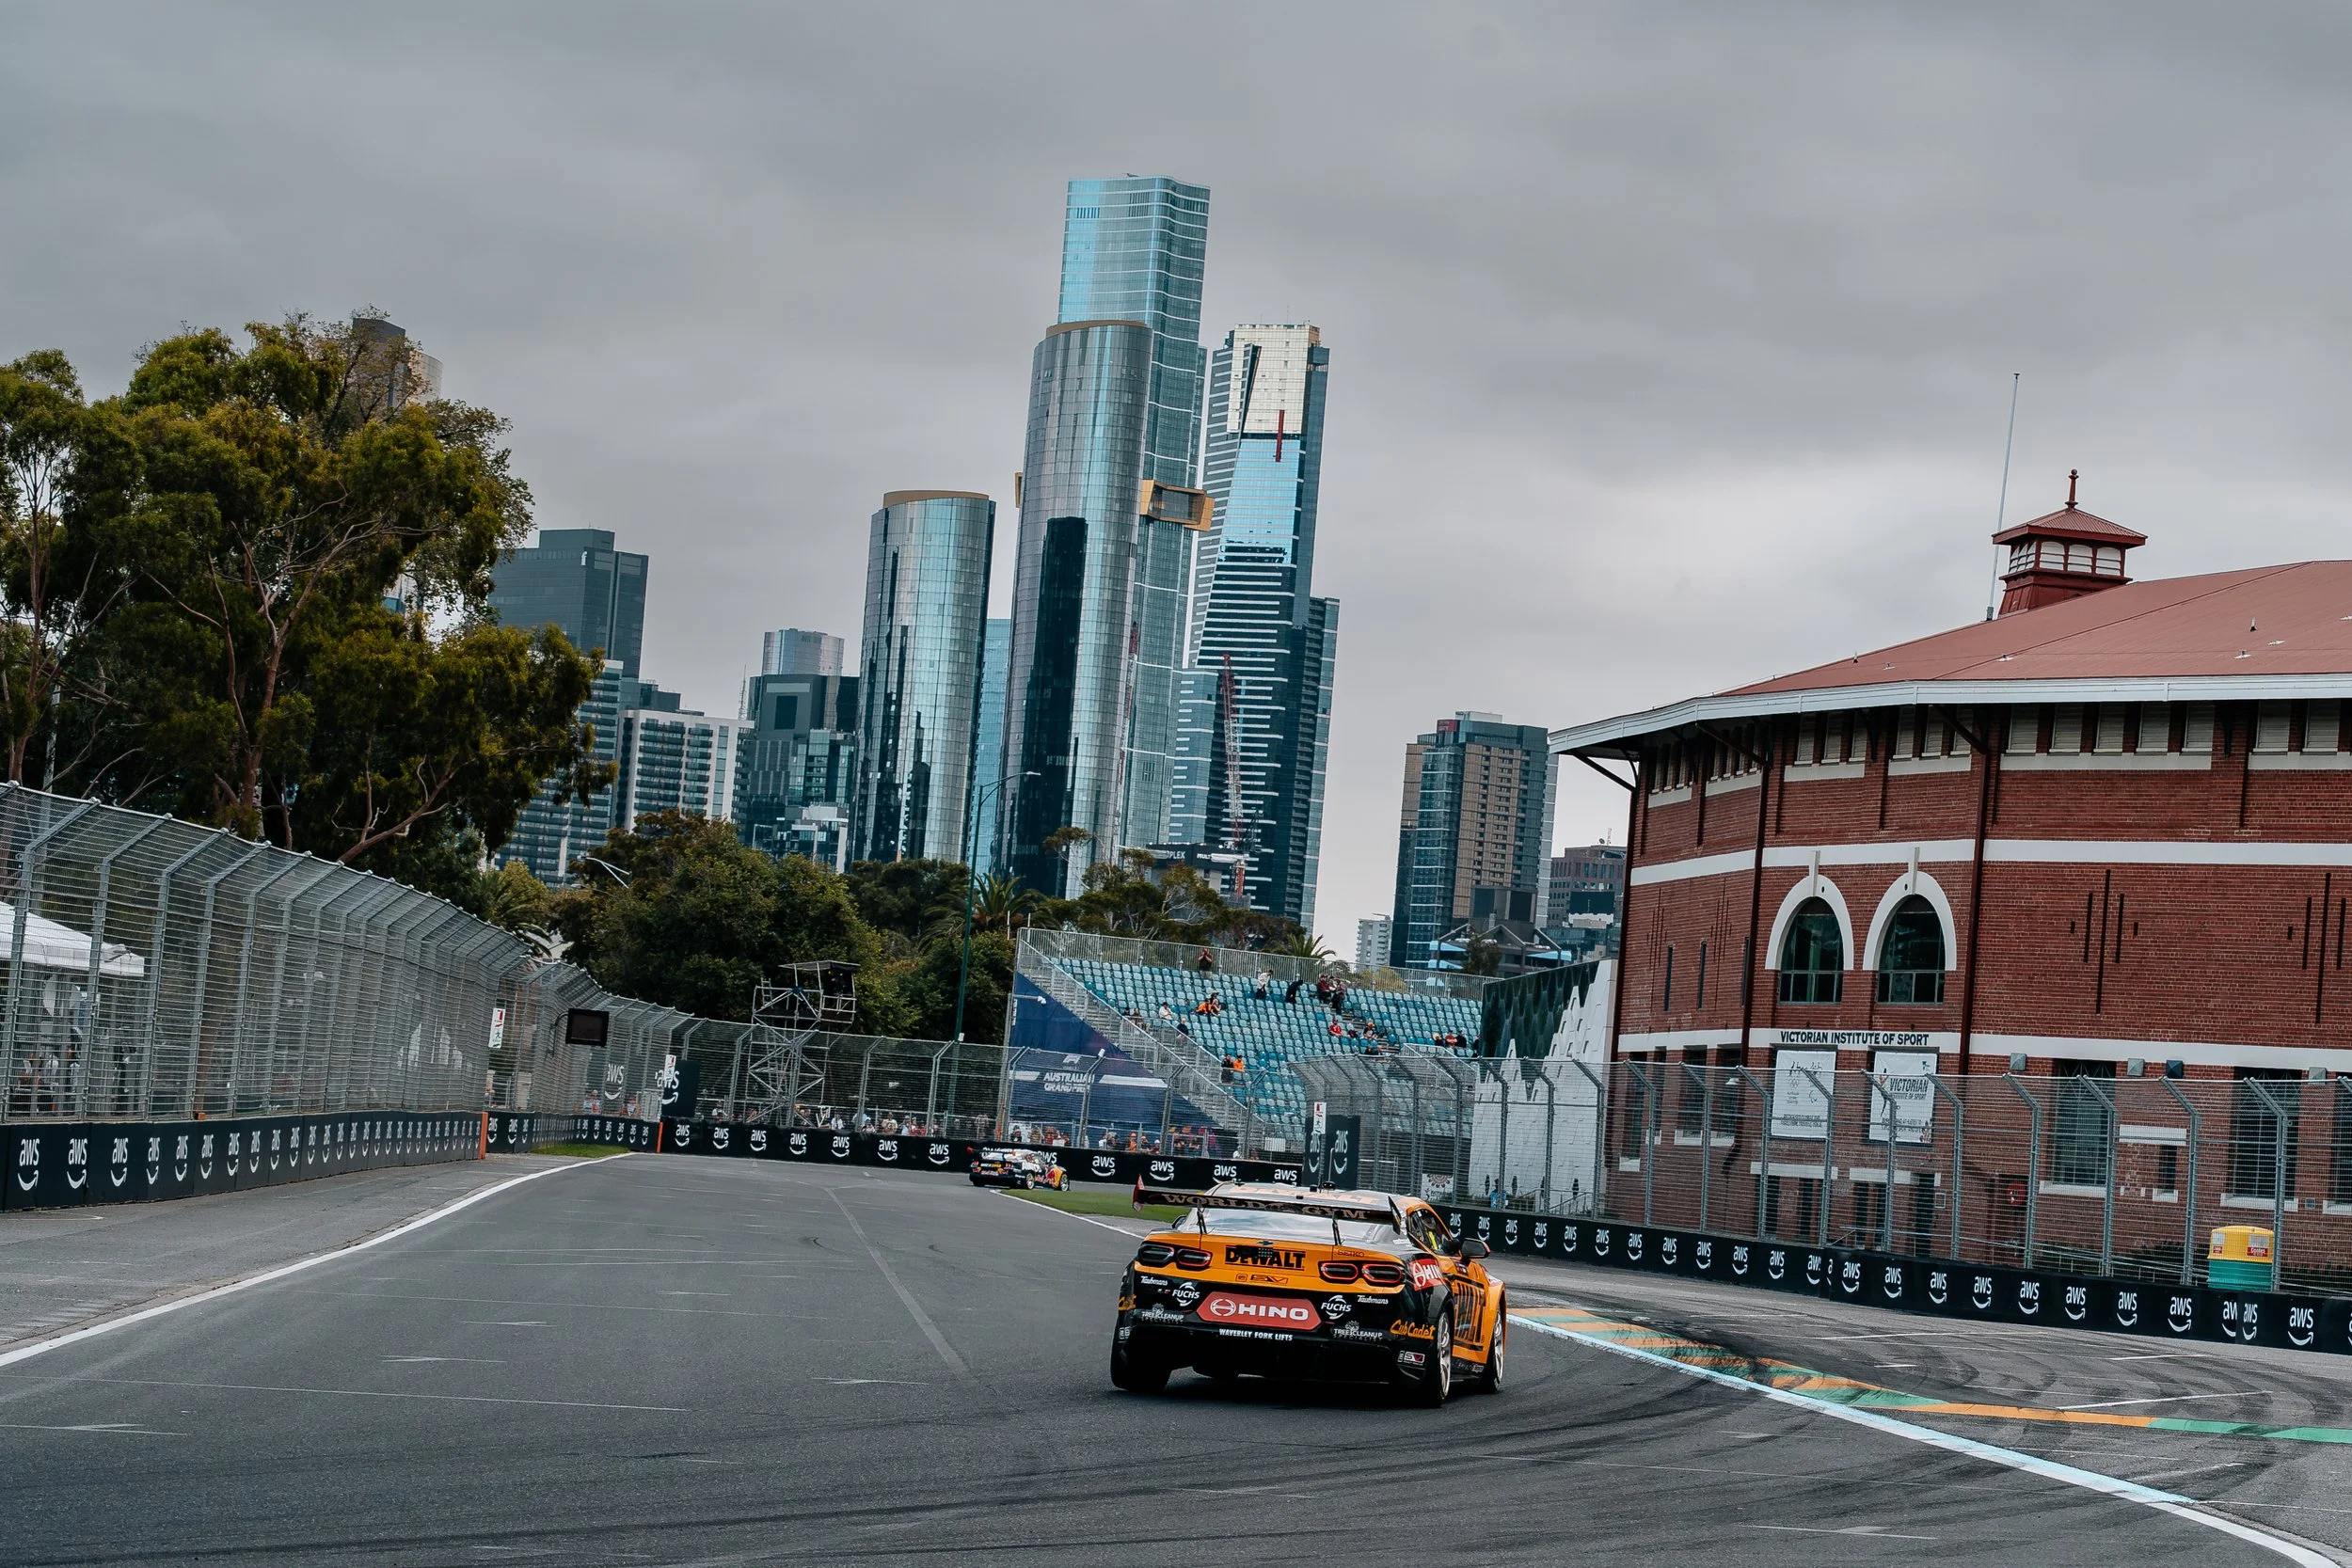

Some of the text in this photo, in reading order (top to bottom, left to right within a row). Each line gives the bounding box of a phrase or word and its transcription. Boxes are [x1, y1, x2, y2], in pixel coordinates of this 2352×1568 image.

[1781, 1031, 1930, 1046] VICTORIAN INSTITUTE OF SPORT
[1889, 1077, 1930, 1093] VICTORIAN
[676, 1124, 690, 1136] aws
[714, 1128, 728, 1139] aws
[752, 1130, 766, 1142] aws
[176, 1135, 188, 1160] aws
[202, 1134, 214, 1158] aws
[229, 1132, 240, 1155] aws
[251, 1131, 261, 1153] aws
[790, 1133, 806, 1147] aws
[833, 1136, 850, 1149] aws
[879, 1140, 898, 1153] aws
[1335, 1130, 1348, 1154] aws
[20, 1139, 40, 1166] aws
[69, 1138, 87, 1164] aws
[113, 1138, 128, 1164] aws
[149, 1137, 160, 1162] aws
[930, 1144, 949, 1157] aws
[1091, 1156, 1115, 1169] aws
[1150, 1161, 1174, 1174] aws
[1213, 1165, 1236, 1179] aws
[1274, 1166, 1298, 1182] aws
[1162, 1193, 1367, 1220] WORLD GYM
[1450, 1213, 1461, 1227] aws
[1478, 1216, 1489, 1229] aws
[1506, 1219, 1518, 1233] aws
[1535, 1223, 1547, 1236] aws
[1565, 1226, 1577, 1240] aws
[1597, 1229, 1609, 1243] aws
[1629, 1233, 1642, 1248] aws
[1663, 1237, 1677, 1253] aws
[1337, 1249, 1364, 1259] SEIKO
[1697, 1242, 1711, 1257] aws
[1734, 1246, 1748, 1262] aws
[1770, 1251, 1785, 1266] aws
[1843, 1261, 1860, 1279] aws
[1885, 1267, 1901, 1284] aws
[1140, 1275, 1168, 1286] Taubmans
[1931, 1272, 1947, 1290] aws
[1974, 1276, 1992, 1294] aws
[1171, 1289, 1200, 1299] FUCHS
[2020, 1281, 2040, 1299] aws
[2066, 1287, 2086, 1305] aws
[1320, 1302, 1352, 1312] FUCHS
[1357, 1294, 1390, 1305] Taubmans
[2119, 1291, 2137, 1310] aws
[2170, 1297, 2191, 1316] aws
[1238, 1303, 1309, 1321] HINO
[2244, 1304, 2257, 1323] aws
[2290, 1307, 2313, 1328] aws
[1219, 1328, 1253, 1338] WAVERLEY
[1254, 1332, 1273, 1340] FORK
[1352, 1330, 1383, 1338] CLEANUP
[1390, 1319, 1436, 1340] Cub Cadet
